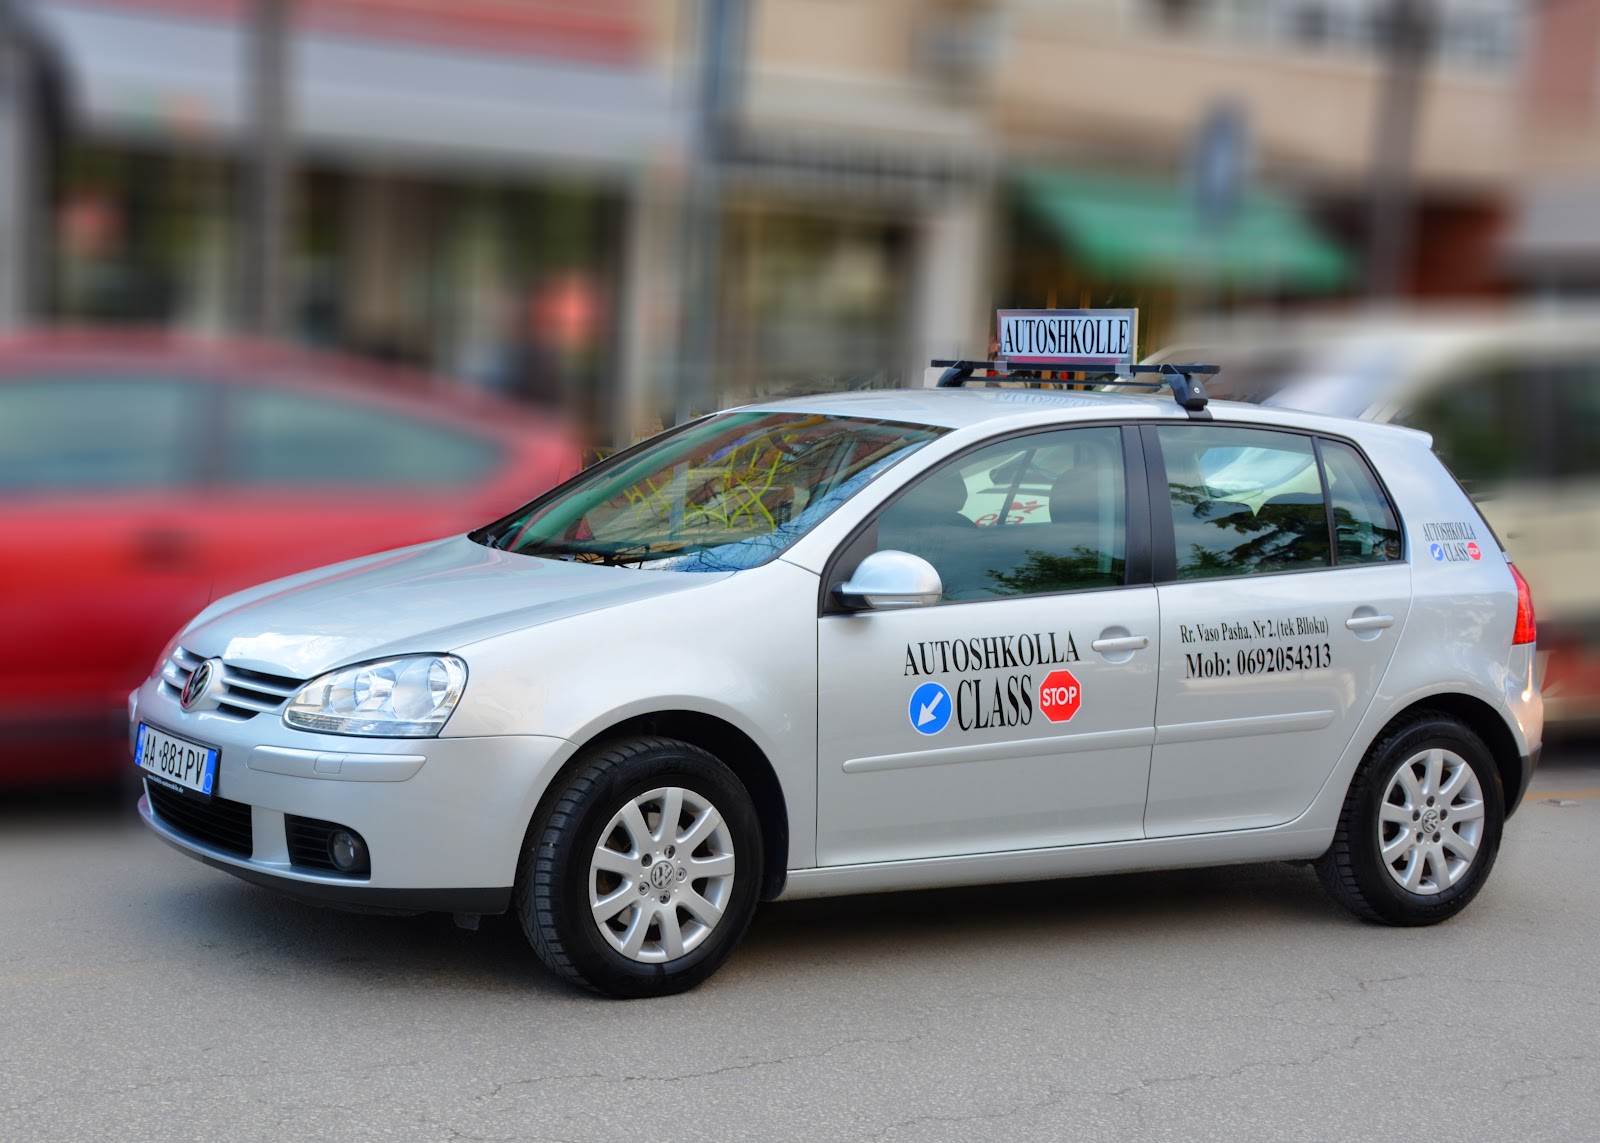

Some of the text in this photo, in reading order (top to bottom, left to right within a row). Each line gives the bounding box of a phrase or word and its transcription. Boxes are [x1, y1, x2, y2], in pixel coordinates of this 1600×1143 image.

[1003, 319, 1128, 354] AUTOSHKOLLE
[1422, 522, 1477, 541] AUTOSHKOLLA
[1442, 542, 1470, 562] CLASS
[1179, 624, 1196, 643] Rr.
[1196, 623, 1219, 642] Vaso
[1220, 621, 1252, 643] Pasha,
[1252, 620, 1266, 639] Nr
[1295, 616, 1329, 637] Blloku)
[904, 630, 1081, 676] AUTOSHKOLLA
[1185, 643, 1331, 679] Mob: 0692054313
[956, 674, 1033, 731] CLASS
[1042, 686, 1078, 707] STOP
[143, 733, 156, 767] AA
